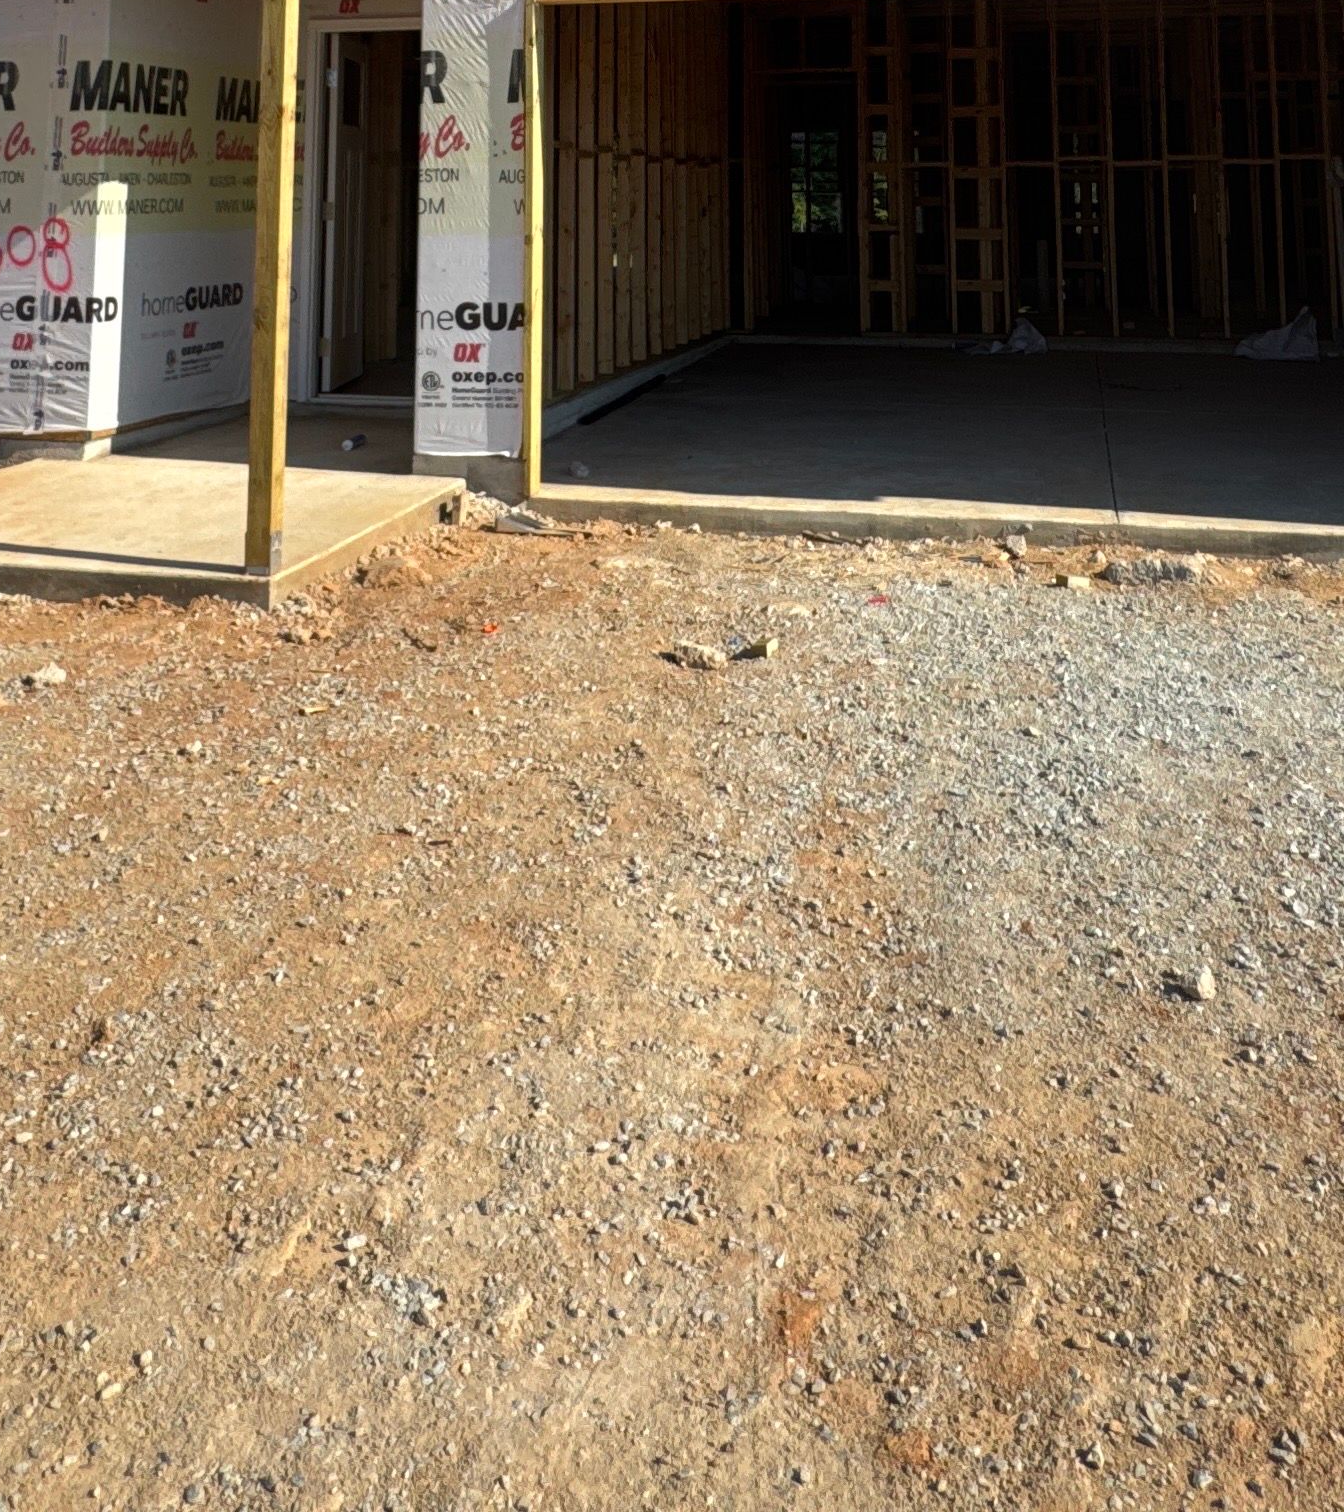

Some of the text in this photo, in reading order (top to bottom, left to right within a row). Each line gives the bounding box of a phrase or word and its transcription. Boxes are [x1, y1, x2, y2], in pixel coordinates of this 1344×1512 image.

[69, 59, 189, 117] MANER
[4, 121, 36, 162] Co.
[70, 120, 199, 166] Builders Supply Co.
[434, 114, 471, 159] Co.
[118, 197, 184, 216] MANER.COM
[141, 281, 244, 319] homeGUARD
[12, 333, 34, 352] OX
[453, 343, 481, 364] OX
[452, 371, 525, 386] oxep.co
